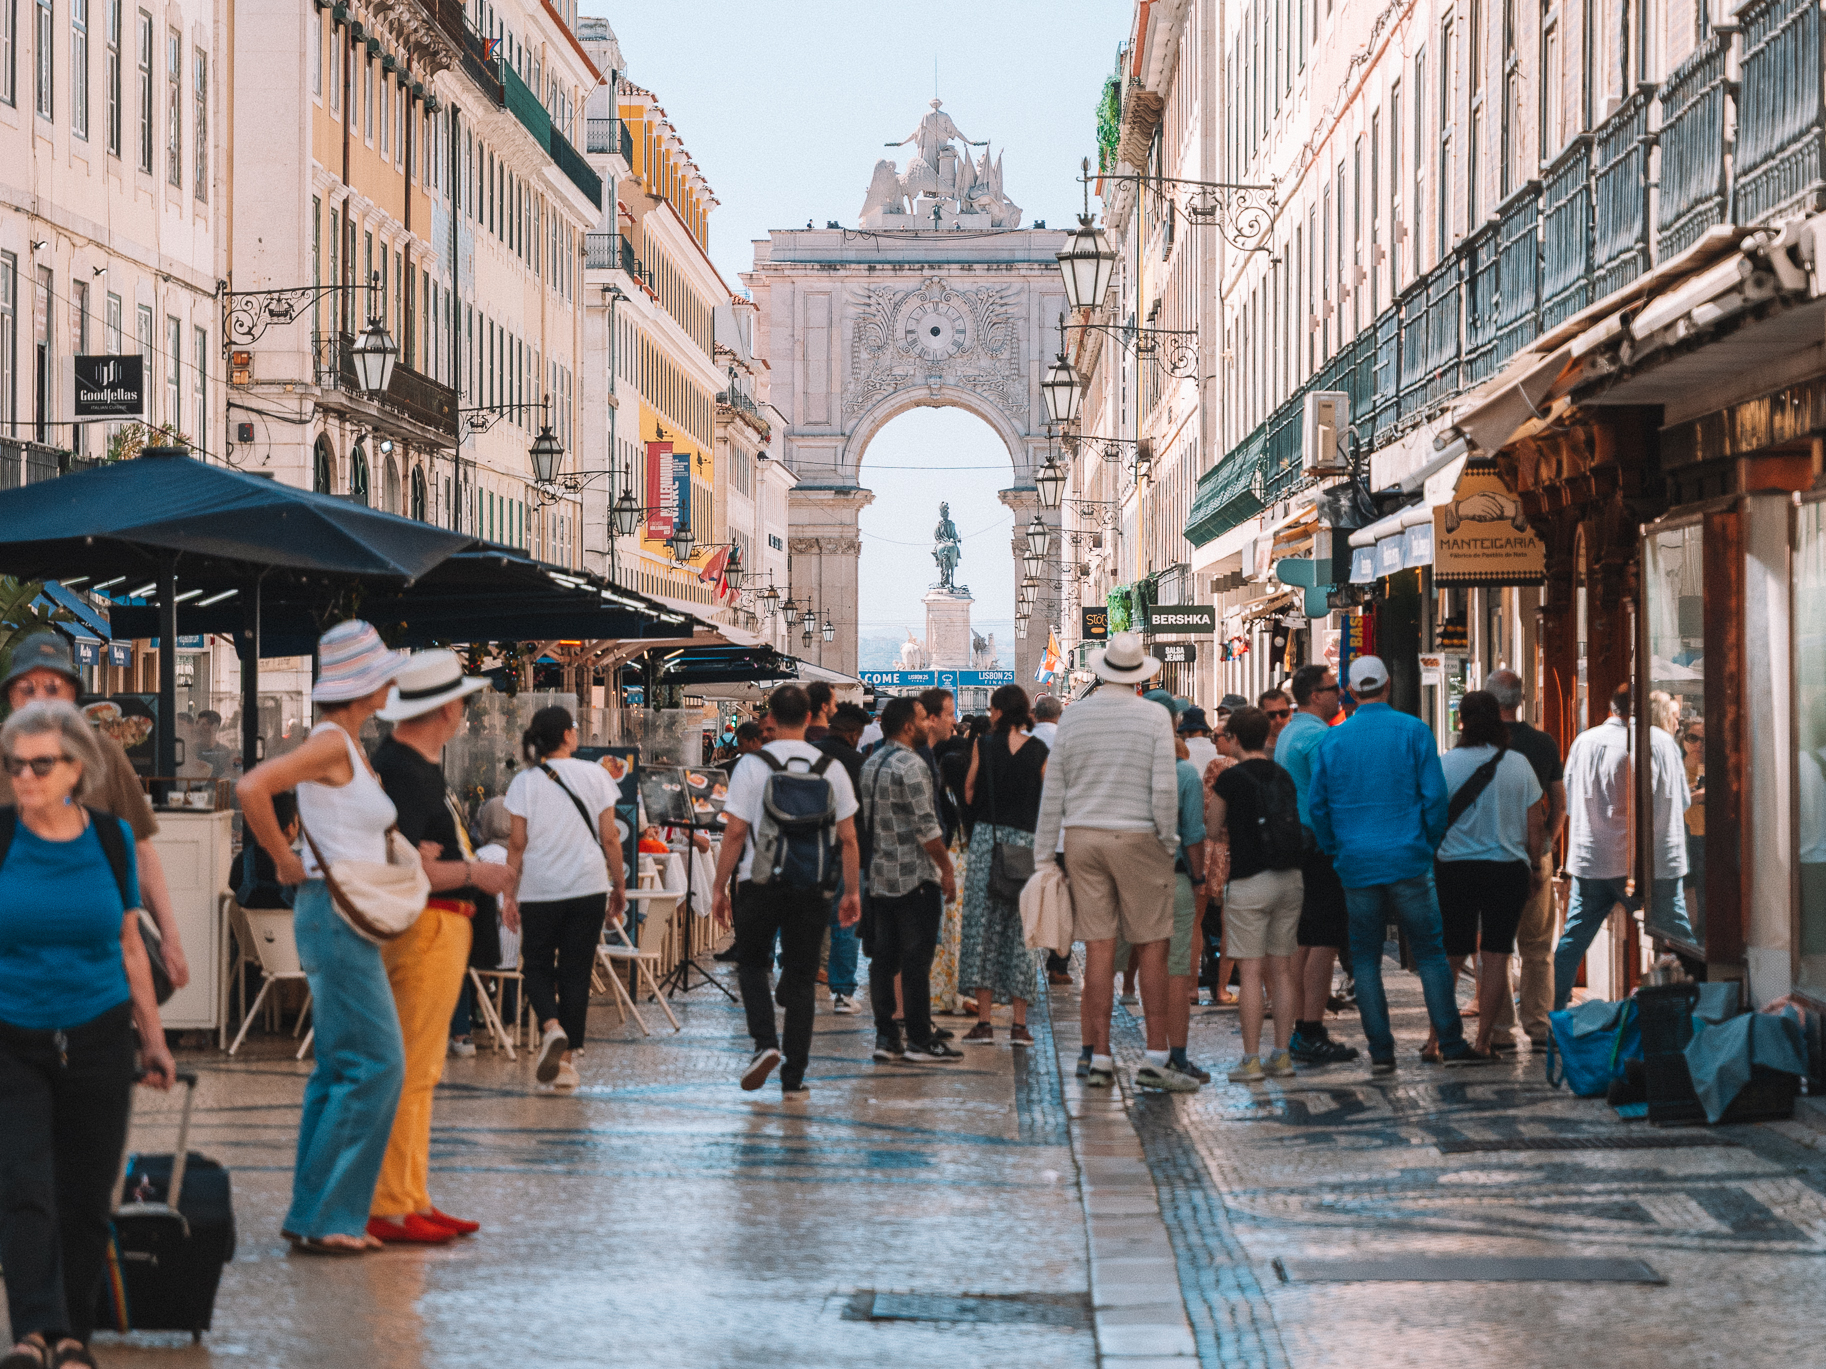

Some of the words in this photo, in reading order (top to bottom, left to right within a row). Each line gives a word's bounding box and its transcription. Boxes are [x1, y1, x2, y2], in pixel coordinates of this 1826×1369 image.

[80, 388, 138, 404] Goodfellas
[1440, 537, 1537, 550] MANTEIGARIA
[1152, 614, 1211, 625] BERSHKA
[1164, 646, 1185, 654] SALSA
[1164, 653, 1185, 662] JEANS
[979, 672, 1003, 680] LISBON
[1003, 672, 1013, 680] 25
